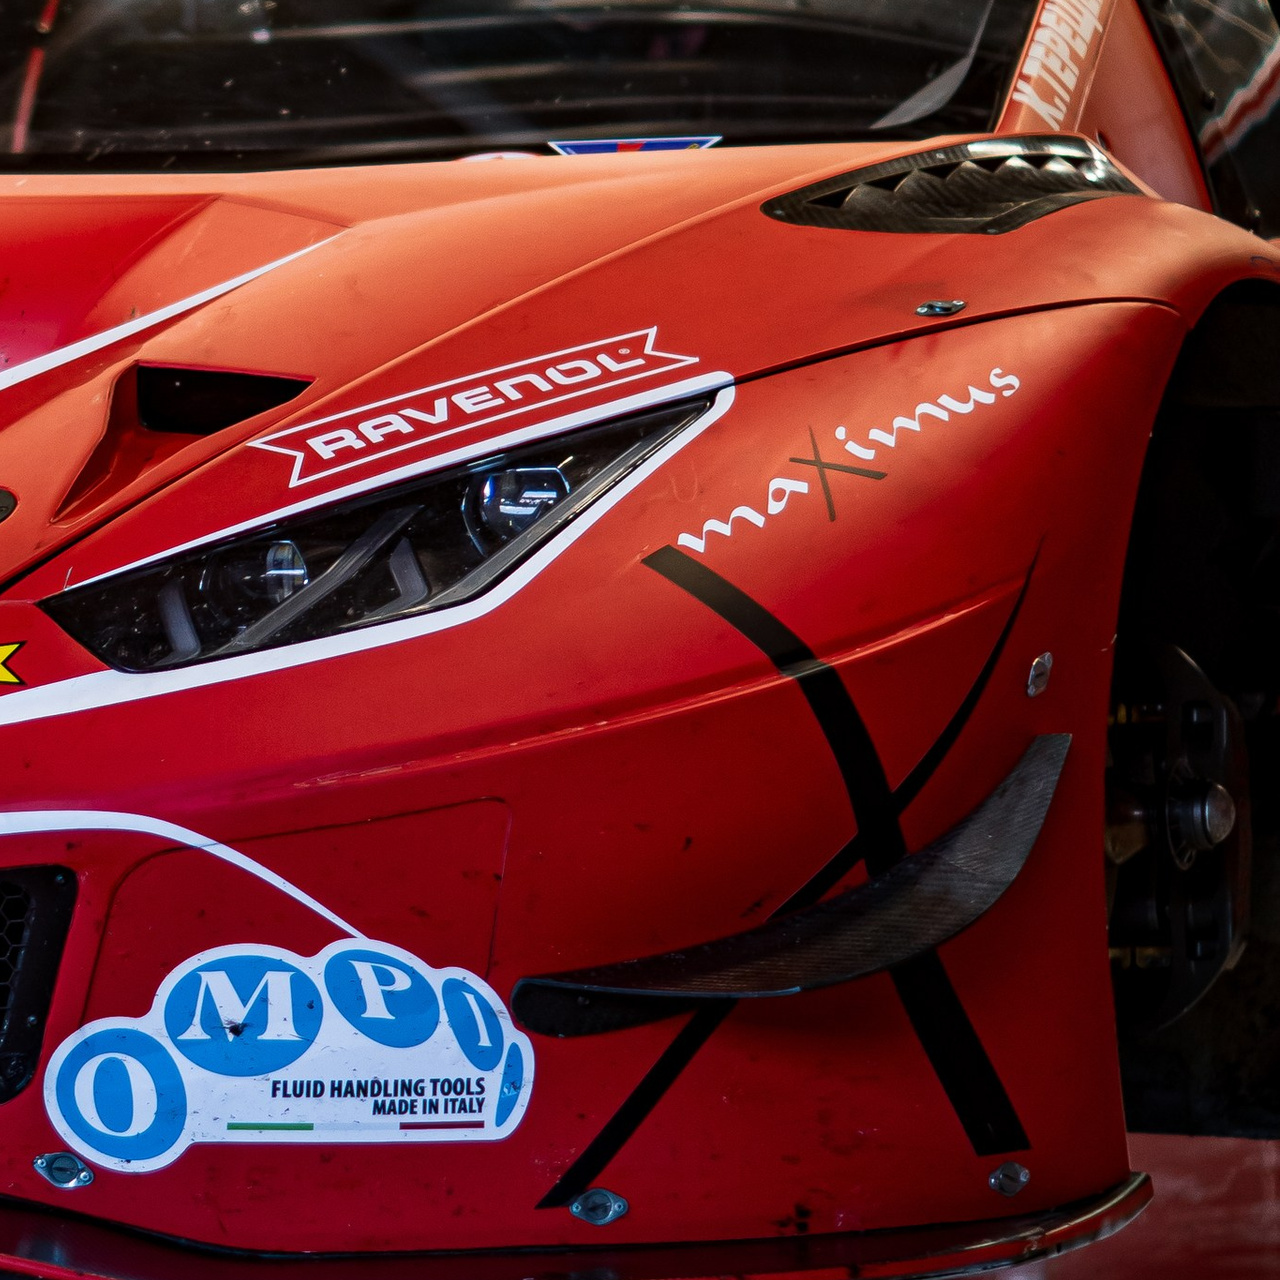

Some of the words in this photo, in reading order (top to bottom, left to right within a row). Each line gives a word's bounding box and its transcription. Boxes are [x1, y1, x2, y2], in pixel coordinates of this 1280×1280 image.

[306, 352, 646, 460] RAVENOL
[271, 1079, 325, 1098] FLUID
[329, 1078, 426, 1098] HANDLING
[429, 1076, 486, 1097] TOOLS
[372, 1099, 418, 1115] MADE
[422, 1099, 439, 1114] IN
[443, 1096, 486, 1114] ITALY
